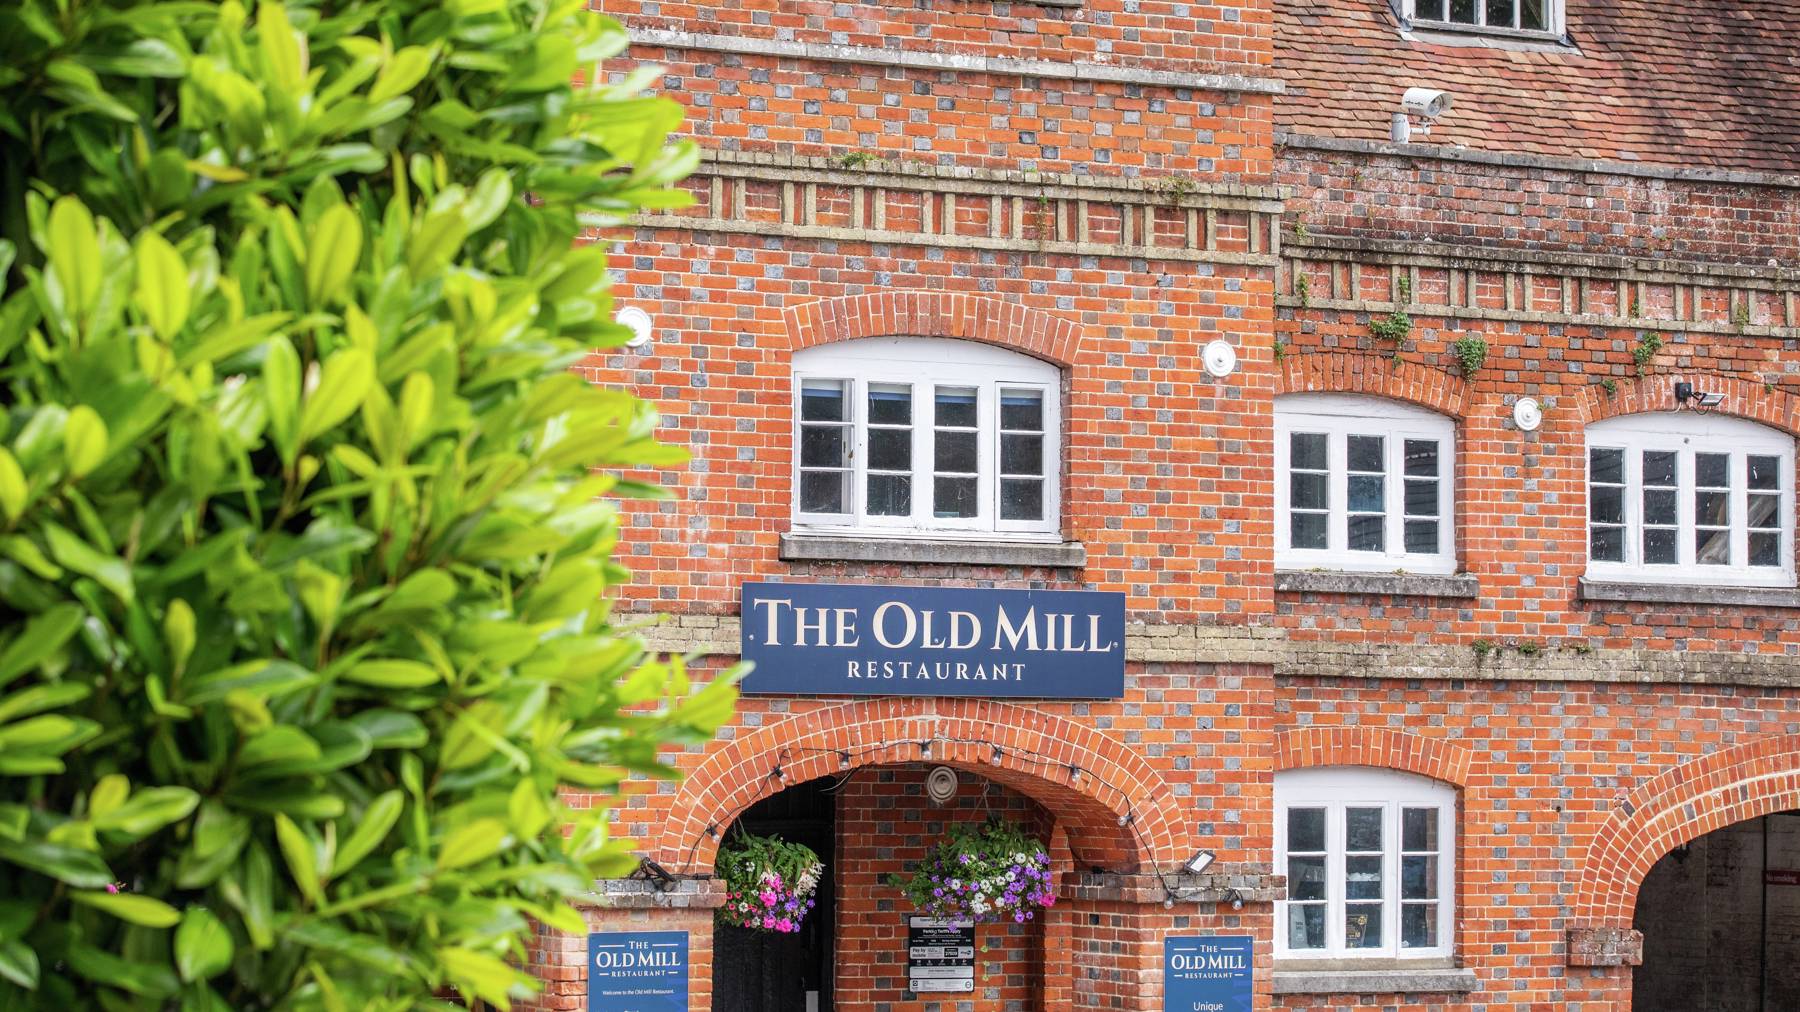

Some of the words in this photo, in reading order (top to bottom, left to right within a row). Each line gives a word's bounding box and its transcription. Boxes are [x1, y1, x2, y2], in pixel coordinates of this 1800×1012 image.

[754, 598, 860, 646] THE
[872, 601, 982, 649] OLD
[990, 604, 1113, 652] MILL
[847, 660, 1026, 681] RESTAURANT
[629, 940, 649, 950] THE
[1200, 944, 1218, 953] THE
[596, 951, 635, 968] OLD
[637, 951, 681, 967] MILL
[1171, 954, 1206, 970] OLD
[1208, 954, 1246, 969] MILL
[611, 970, 666, 978] RESTAURANT
[1193, 1001, 1224, 1012] Unique
